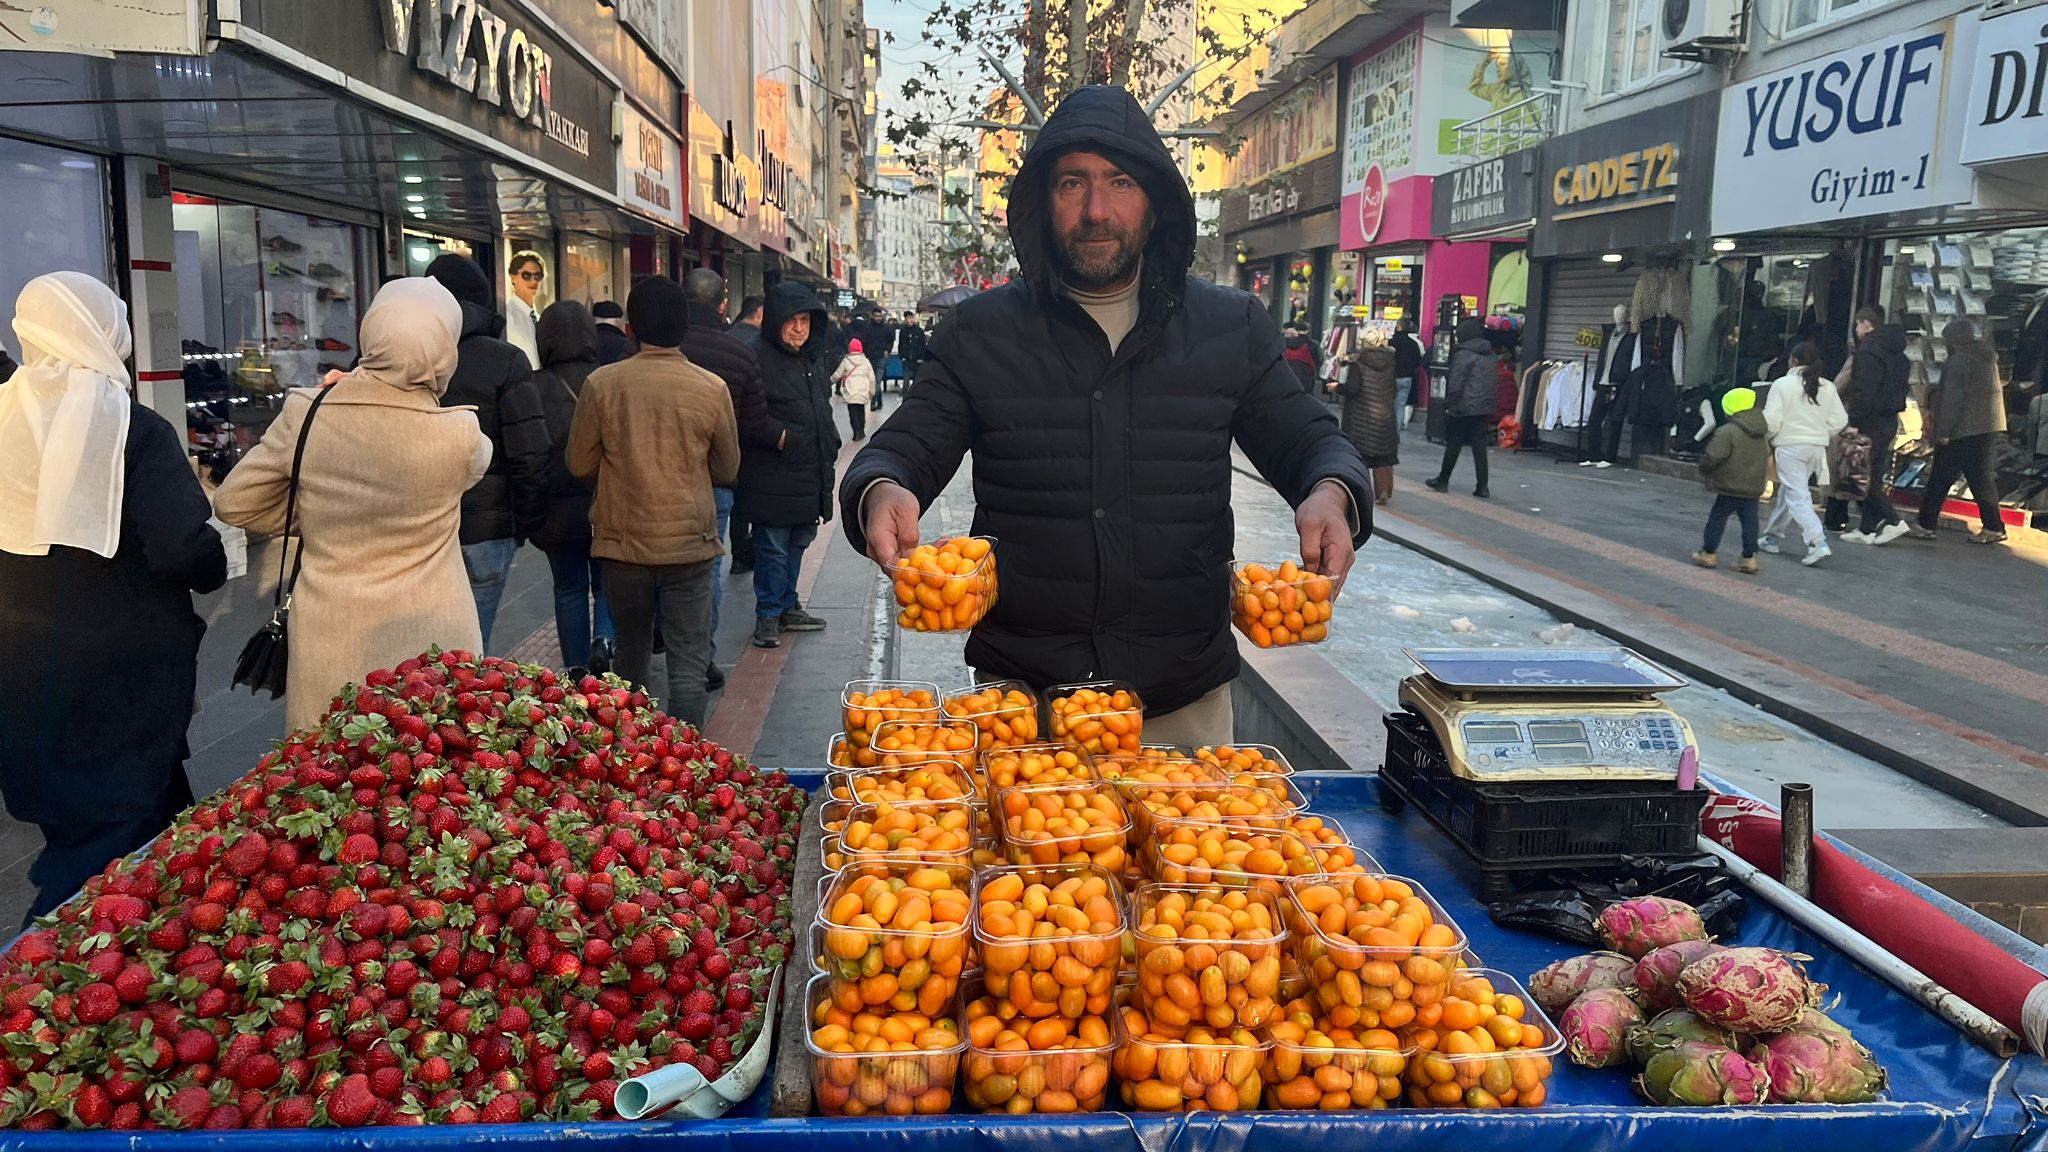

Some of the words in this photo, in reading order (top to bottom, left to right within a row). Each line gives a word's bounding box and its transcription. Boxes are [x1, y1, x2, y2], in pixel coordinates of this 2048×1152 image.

[1743, 32, 1945, 158] YUSUF
[1452, 158, 1505, 204] ZAFER
[1552, 148, 1642, 207] CADDE
[1641, 142, 1681, 190] 72
